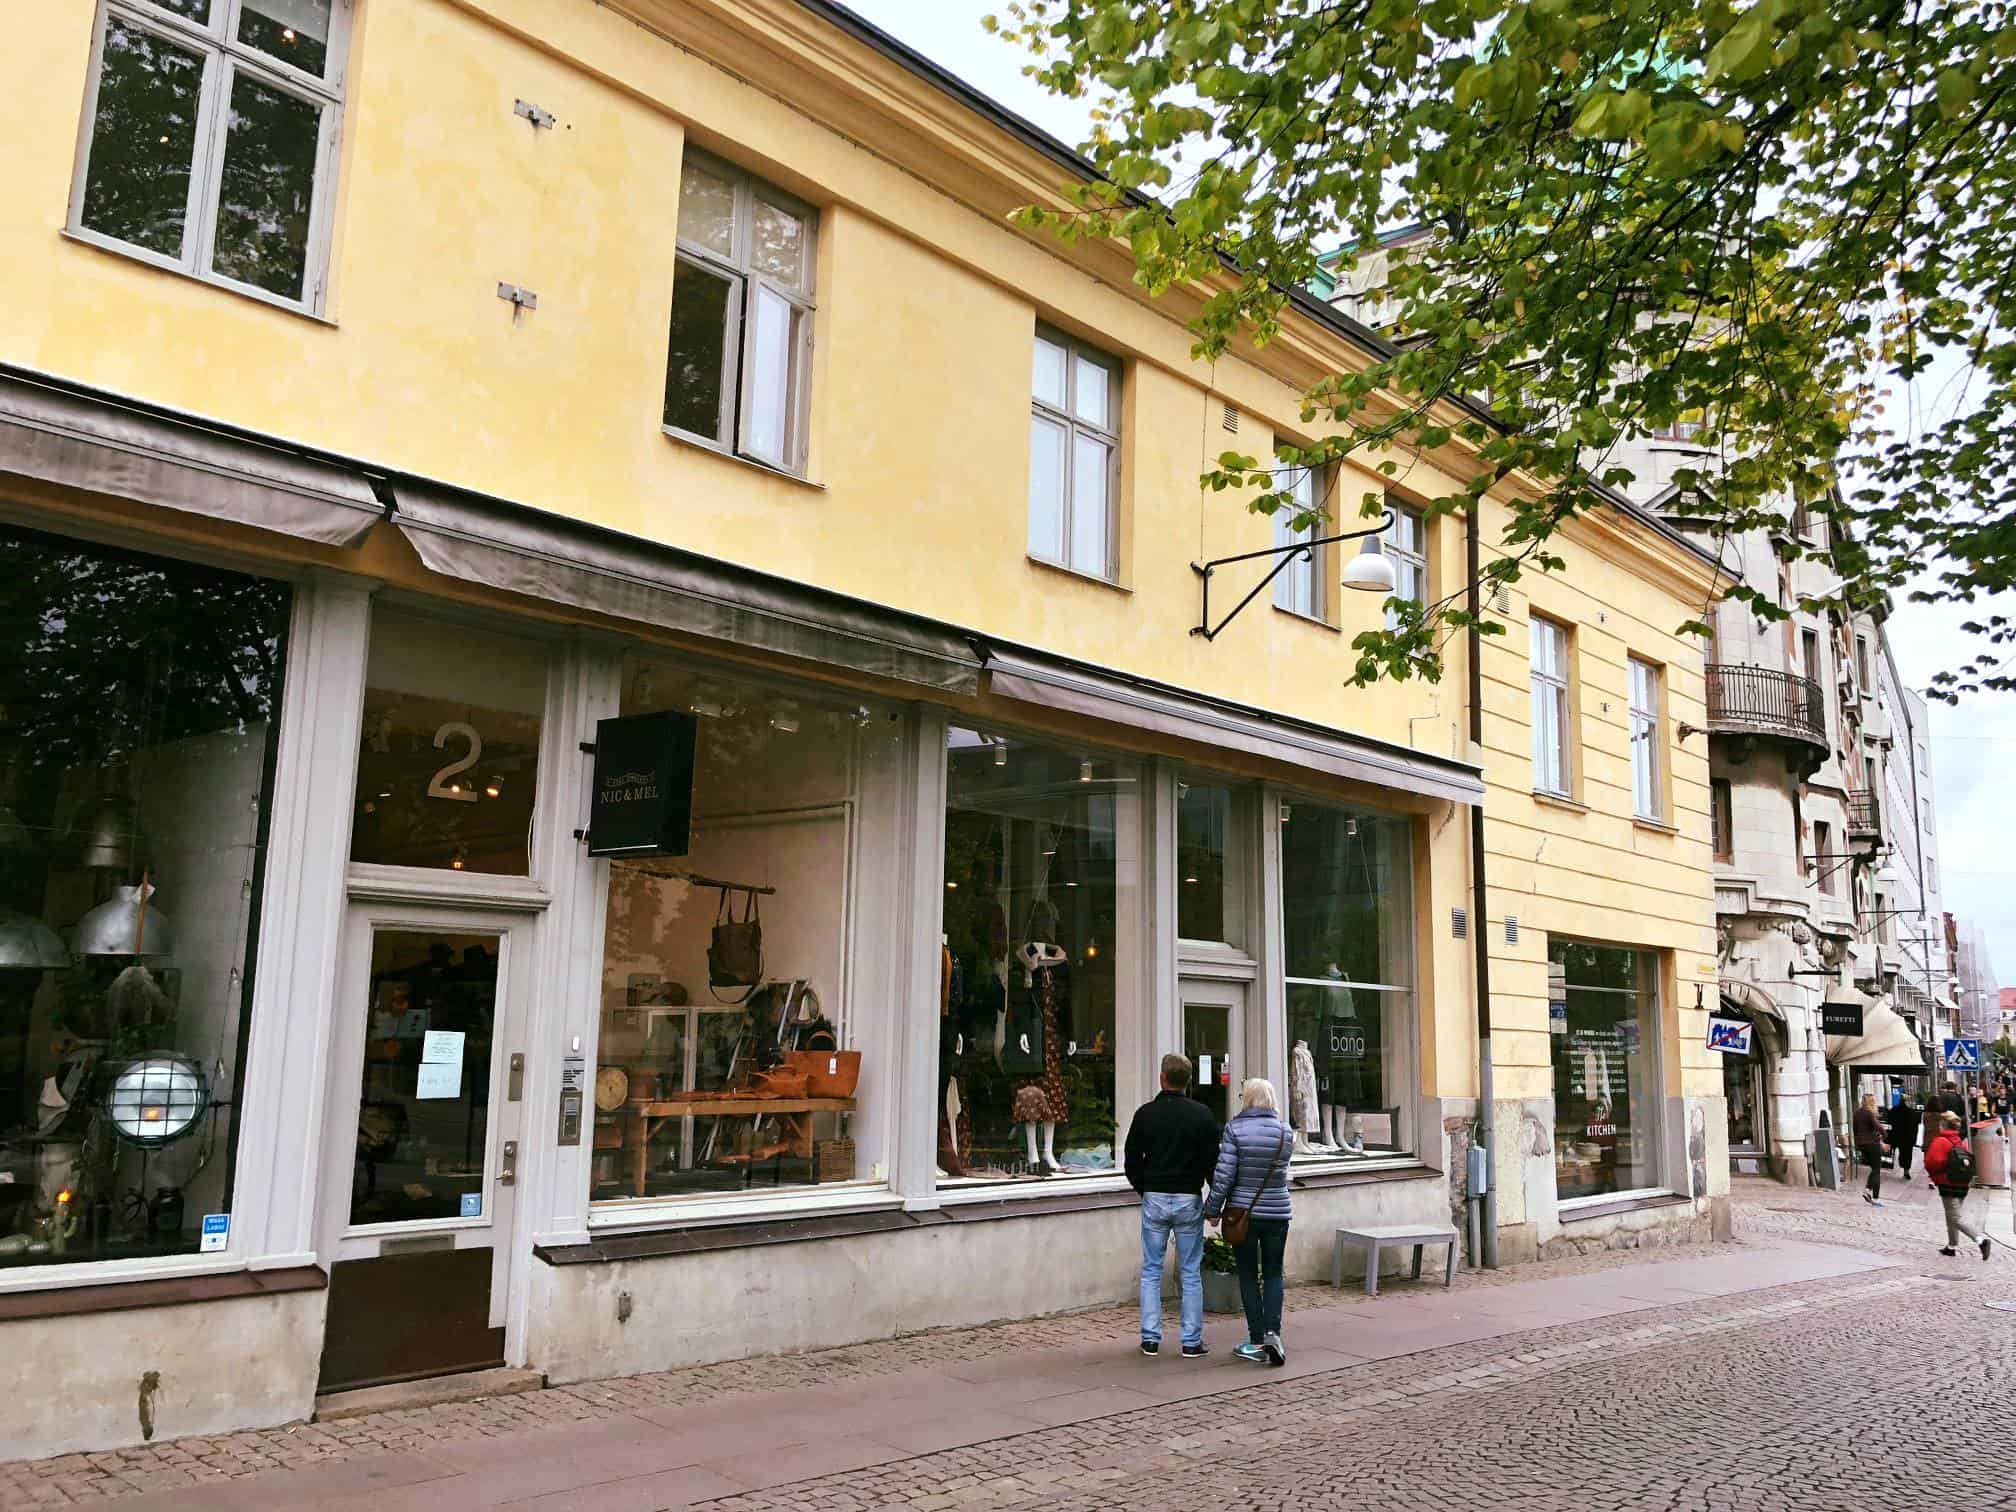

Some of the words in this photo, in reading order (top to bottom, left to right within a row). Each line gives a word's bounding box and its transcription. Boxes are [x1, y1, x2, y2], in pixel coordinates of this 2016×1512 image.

[427, 722, 482, 802] 2
[600, 784, 657, 804] NIC&MEL
[1586, 1123, 1617, 1137] KITCHEN
